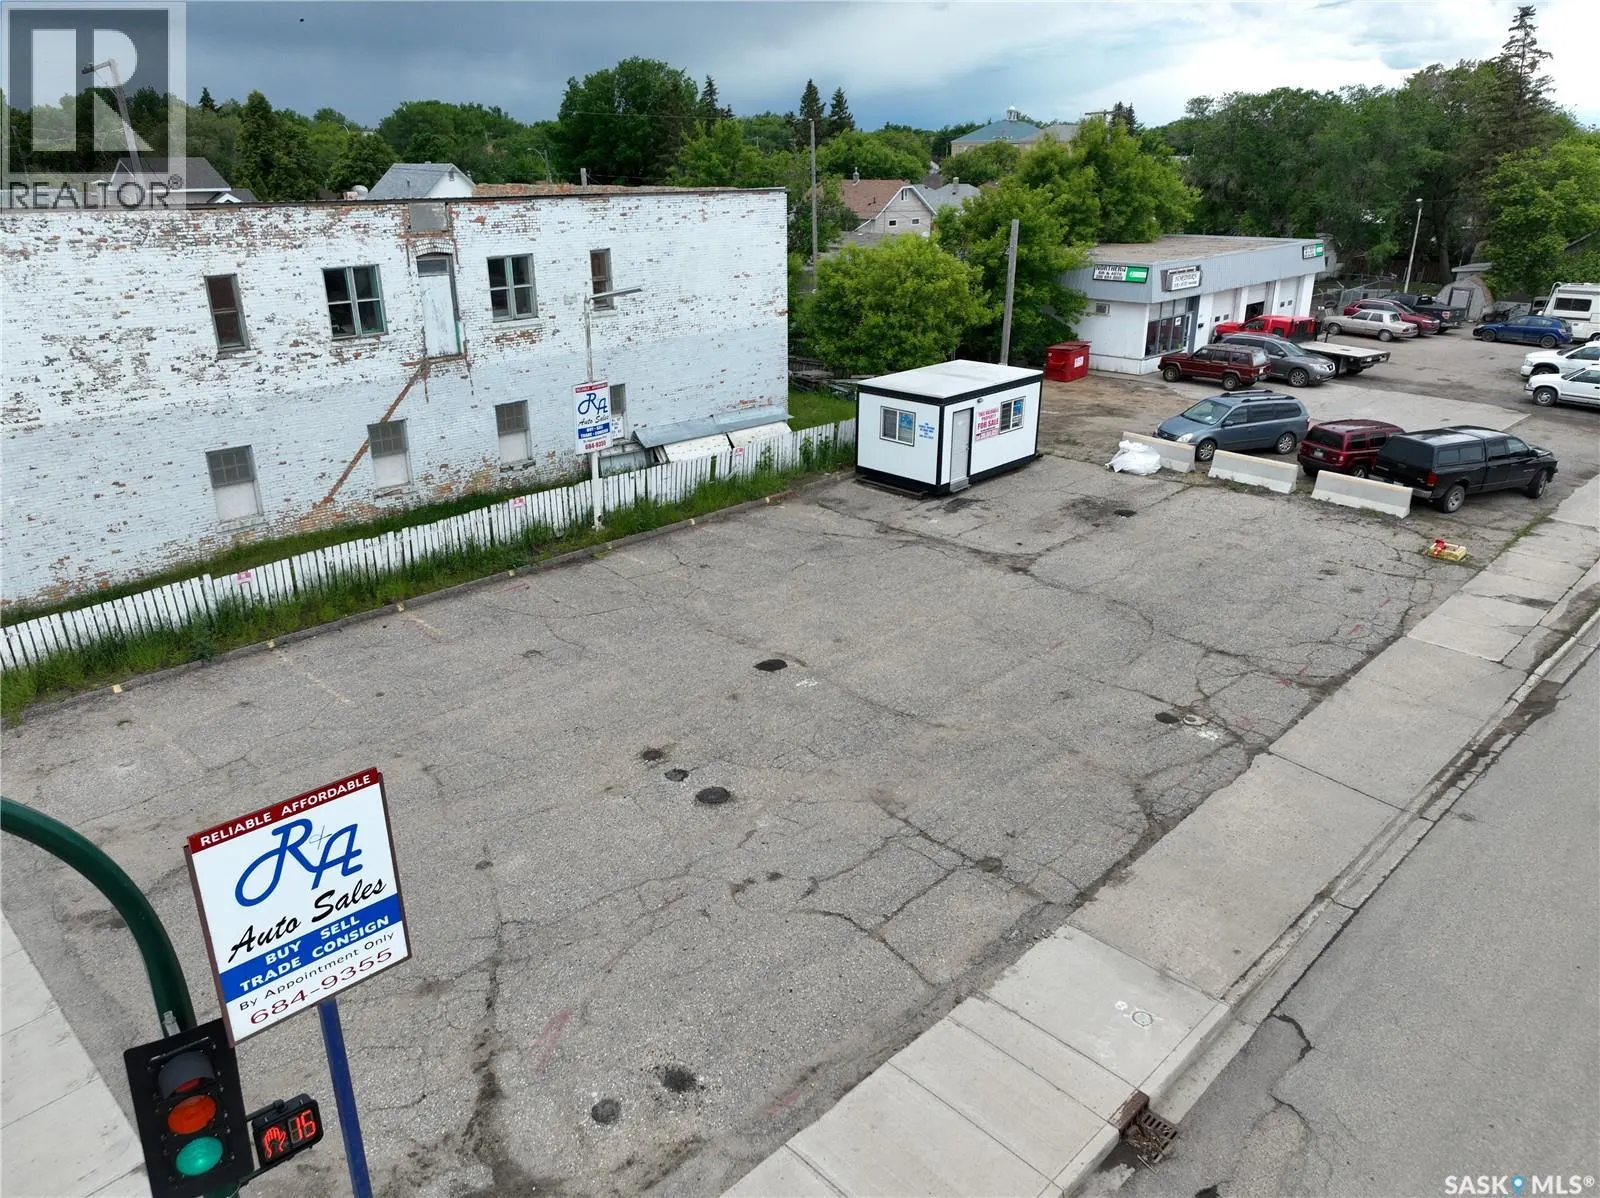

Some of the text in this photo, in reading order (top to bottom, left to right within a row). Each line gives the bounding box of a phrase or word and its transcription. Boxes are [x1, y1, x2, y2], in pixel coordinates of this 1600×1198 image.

[578, 415, 609, 426] Auto Sales
[977, 418, 999, 430] FOR SALE
[200, 774, 371, 847] RELIABLE AFFORDABLE
[228, 878, 387, 963] Auto Sales
[240, 915, 390, 992] TRADE CONSIGN
[265, 914, 360, 965] BUY SELL
[239, 931, 395, 1012] By Appointment Only
[251, 948, 392, 1025] 684-9355
[294, 1108, 317, 1141] 16
